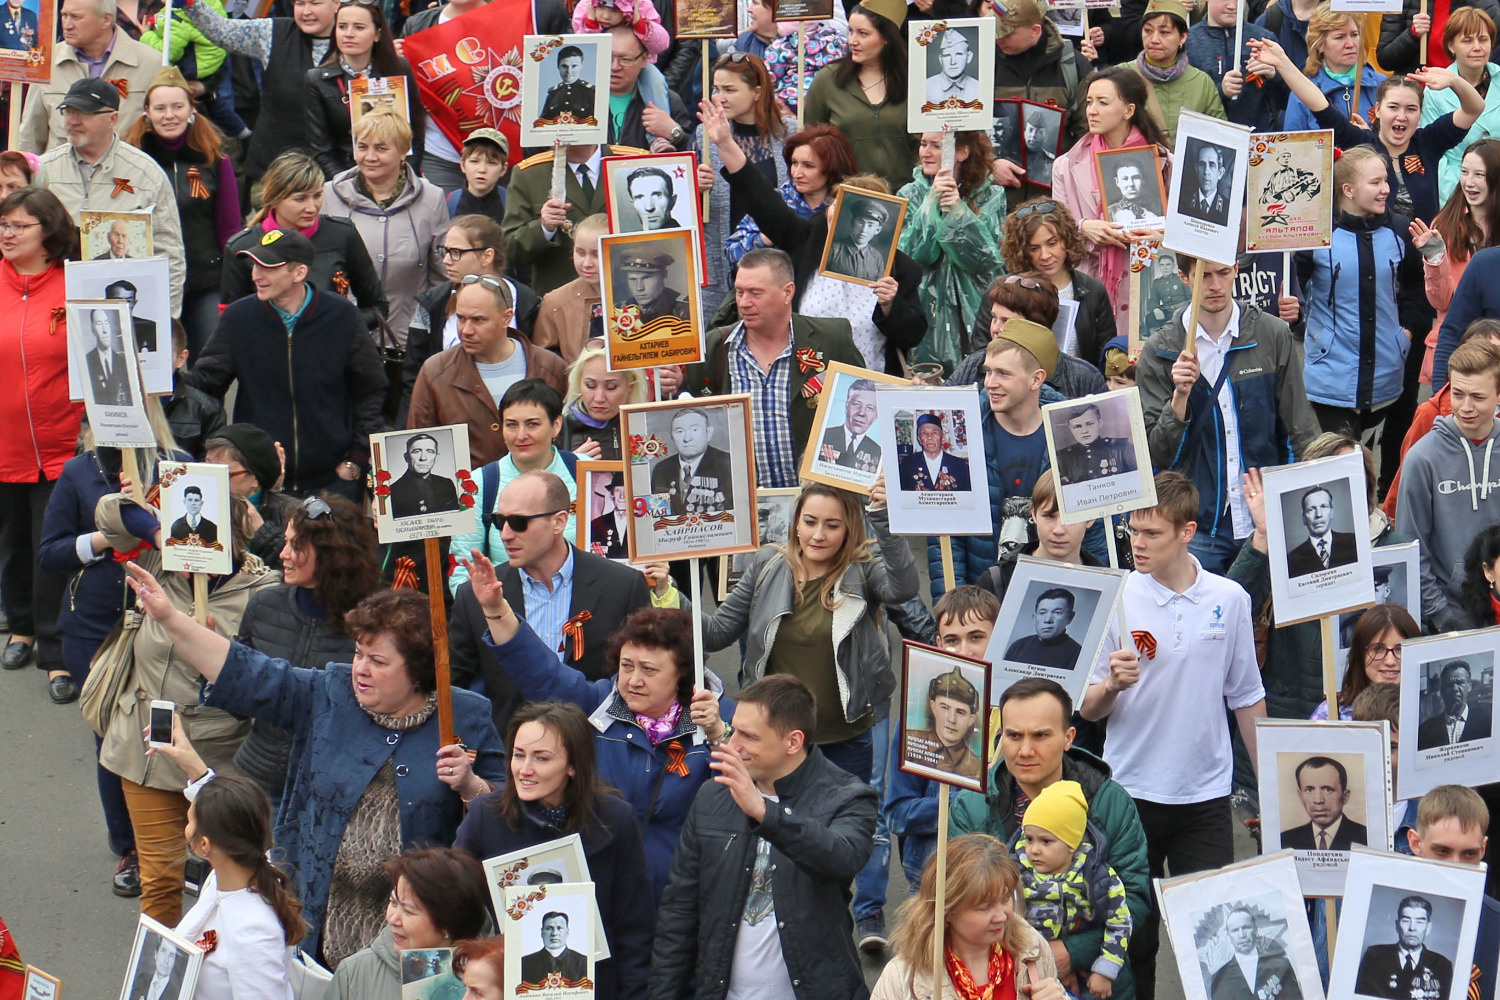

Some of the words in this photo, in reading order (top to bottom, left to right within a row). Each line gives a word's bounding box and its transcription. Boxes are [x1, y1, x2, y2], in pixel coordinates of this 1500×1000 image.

[639, 340, 670, 351] АХТАРИЕВ
[613, 351, 660, 364] ГАЙНЕЛЬГИЛЕМ
[661, 347, 698, 358] САБИРОВИЧ
[1087, 480, 1116, 492] Танков
[1076, 497, 1098, 507] Иван
[1099, 489, 1138, 502] Петрович
[646, 507, 668, 517] МАЯ
[409, 530, 440, 539] 1927-2006
[1297, 580, 1320, 588] Евгений
[1320, 570, 1353, 584] Дмитриевич
[1003, 667, 1036, 675] Александр
[1034, 670, 1067, 680] Дмитриевич
[1026, 664, 1047, 672] Тиунов
[1425, 750, 1450, 760] Николай
[1450, 746, 1484, 756] Степанович
[1443, 754, 1466, 764] рядовой
[1312, 860, 1338, 869] рядовой
